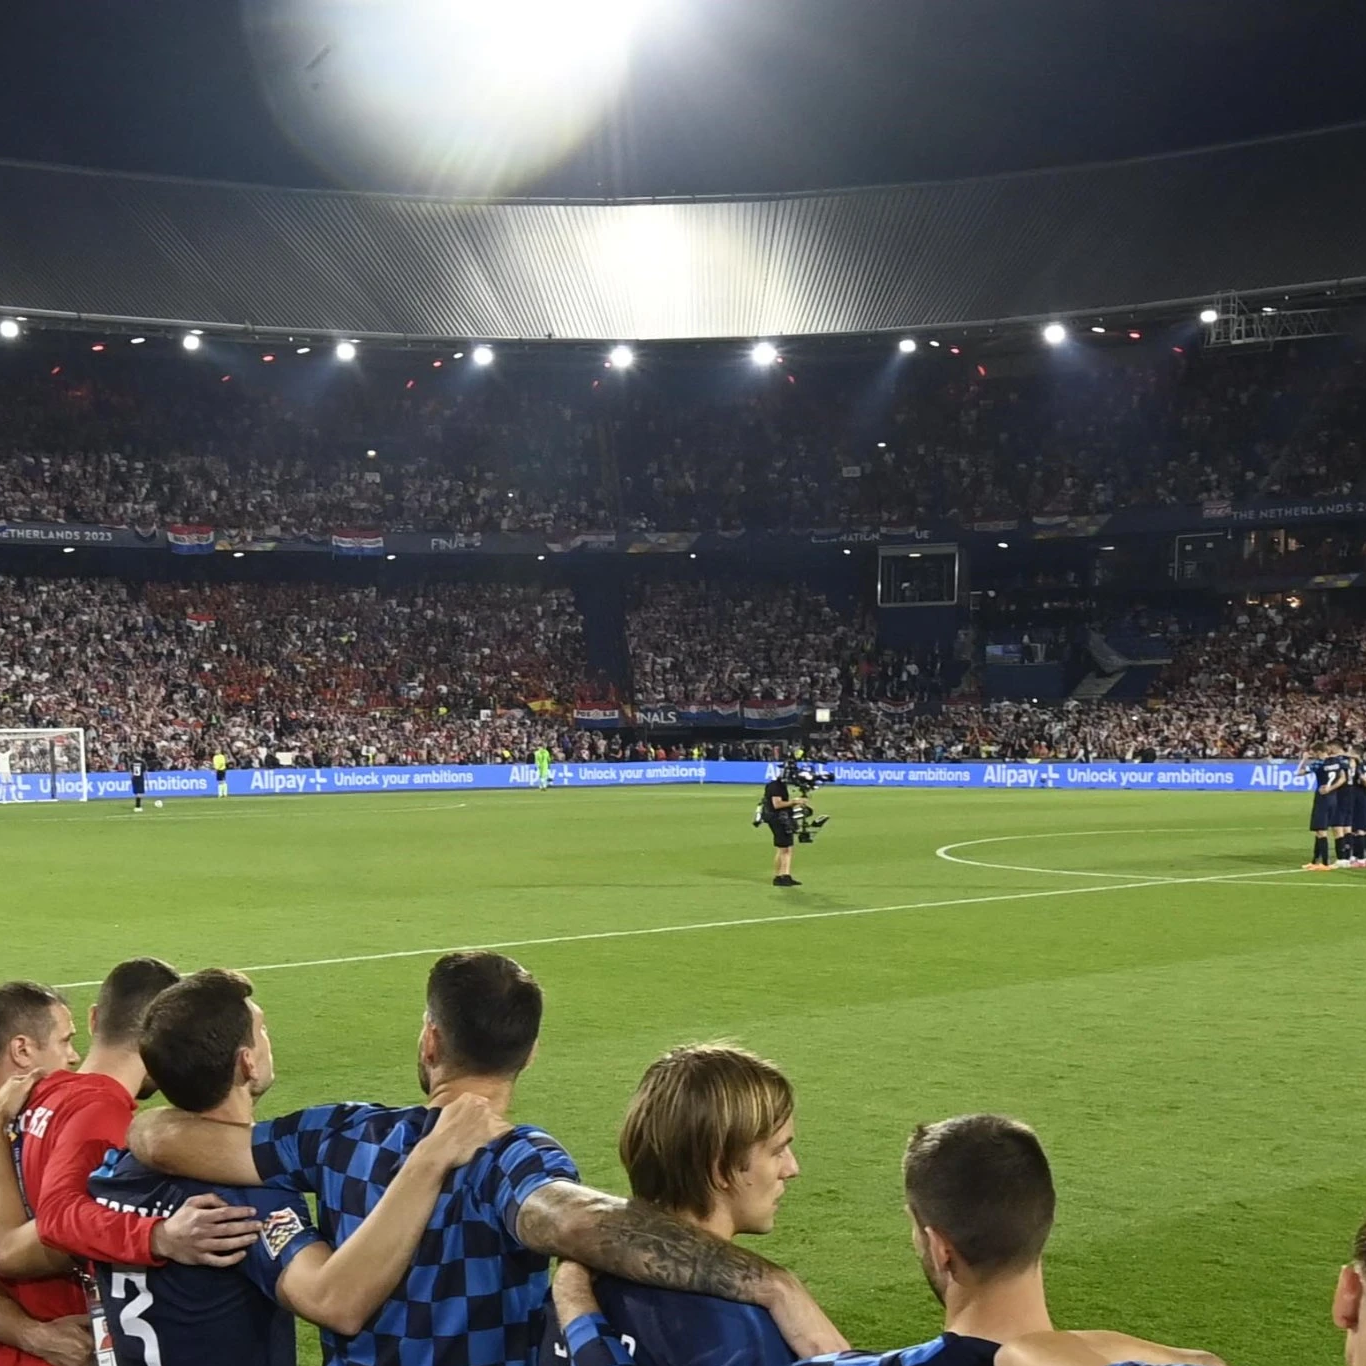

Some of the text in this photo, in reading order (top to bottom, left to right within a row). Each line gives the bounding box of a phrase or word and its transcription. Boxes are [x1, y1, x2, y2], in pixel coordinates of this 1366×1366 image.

[1234, 510, 1256, 521] THE
[1258, 503, 1353, 520] NETHERLANDS
[84, 531, 113, 542] 2023
[334, 772, 379, 786] Unlock
[381, 774, 412, 788] your
[413, 770, 474, 784] ambitions
[579, 767, 617, 780] Unlock
[619, 769, 645, 782] your
[645, 765, 706, 778] ambitions
[835, 767, 875, 780] Unlock
[878, 769, 906, 782] your
[908, 767, 971, 781] ambitions
[1067, 768, 1117, 783] Unlock
[1120, 770, 1153, 786] your
[1157, 768, 1235, 783] ambitions
[97, 780, 132, 795] your
[144, 776, 208, 791] mbitions
